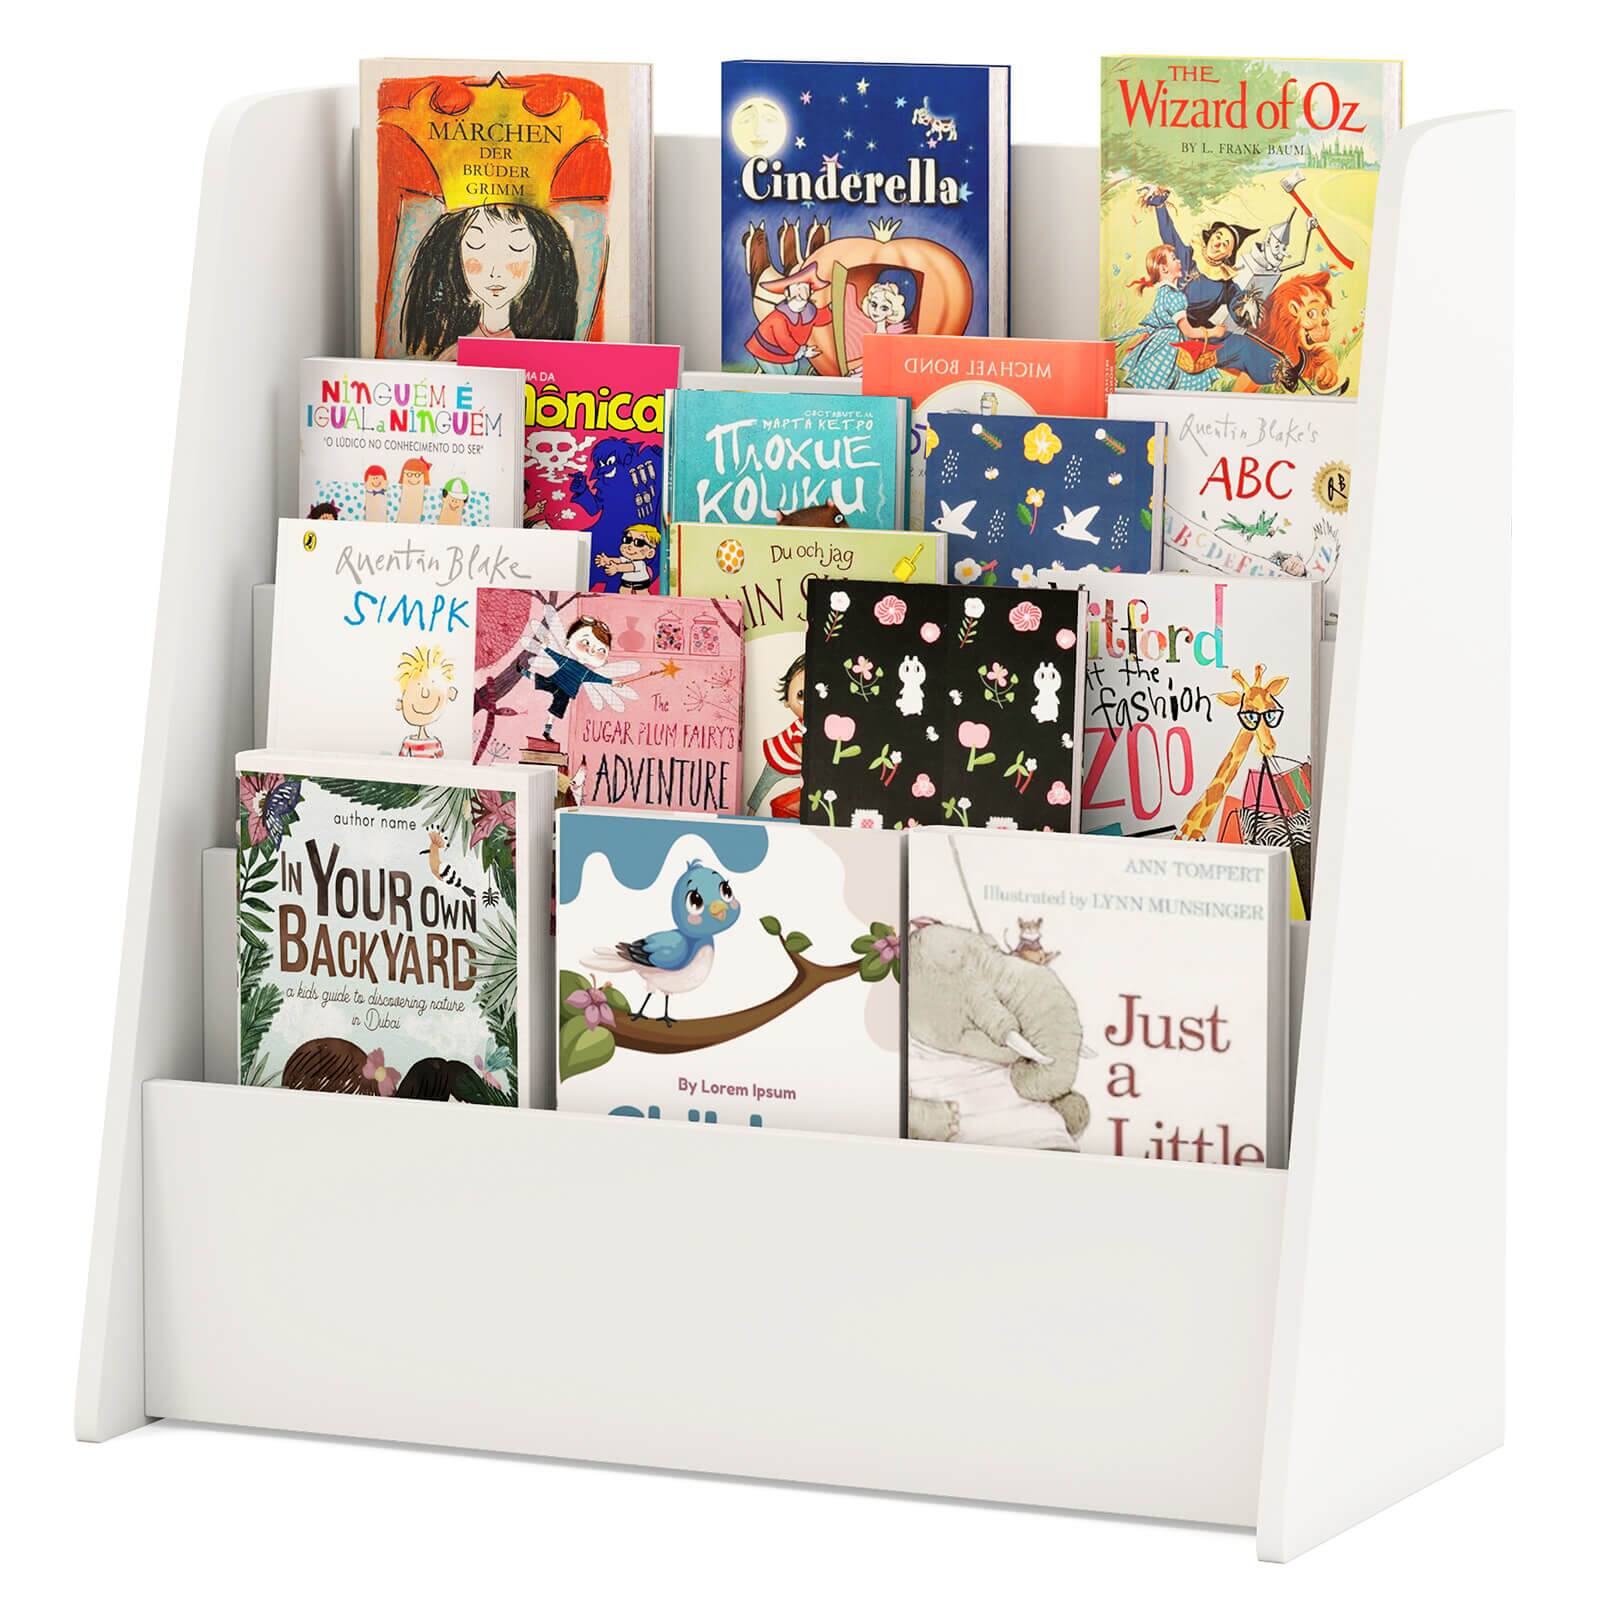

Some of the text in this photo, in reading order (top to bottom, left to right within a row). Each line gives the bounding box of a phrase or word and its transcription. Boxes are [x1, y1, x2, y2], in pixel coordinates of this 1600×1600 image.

[1168, 66, 1220, 83] THE
[1118, 78, 1368, 133] Wizard of Oz
[427, 119, 563, 144] MÄRCHEN
[480, 147, 512, 160] DER
[1181, 143, 1305, 156] BY L. FRANK BAUM
[463, 163, 530, 178] BRÜDER
[741, 156, 959, 205] Cinderella
[466, 182, 524, 196] GRIMM
[540, 372, 555, 382] DA
[456, 381, 472, 410] É
[307, 405, 374, 432] IGUAL
[376, 419, 385, 433] a
[763, 418, 873, 431] МАРТА КЕТРО
[335, 436, 366, 449] LÚDICO
[369, 439, 381, 449] NO
[384, 441, 449, 453] CONHECIMENTO
[452, 443, 465, 453] DO
[1180, 412, 1318, 457] Quentin Blake's
[1199, 456, 1296, 501] ABC
[335, 539, 532, 587] Quentin Blake
[771, 541, 854, 570] Du och jag
[739, 579, 784, 631] IN
[1048, 582, 1228, 669] itford
[1119, 657, 1159, 687] the
[652, 693, 669, 712] The
[1091, 678, 1212, 741] fashion
[583, 719, 735, 750] SUGAR PLUM FAIRY'S
[592, 753, 730, 810] ADVENTURE
[1082, 722, 1194, 820] ZOO
[334, 810, 417, 831] author name
[281, 839, 477, 933] IN YOUR OWN
[1125, 859, 1265, 884] ANN TOMPERT
[983, 884, 1265, 921] Illustrated by LYNN MUNSINGER
[279, 904, 477, 991] BACKYARD
[286, 981, 466, 1016] a kids guide to discovering nature
[351, 1007, 401, 1032] in Dubai
[1105, 994, 1231, 1053] Just
[678, 1077, 797, 1102] By Lorem Ipsum
[1106, 1062, 1140, 1098] a
[1107, 1117, 1265, 1166] Little
